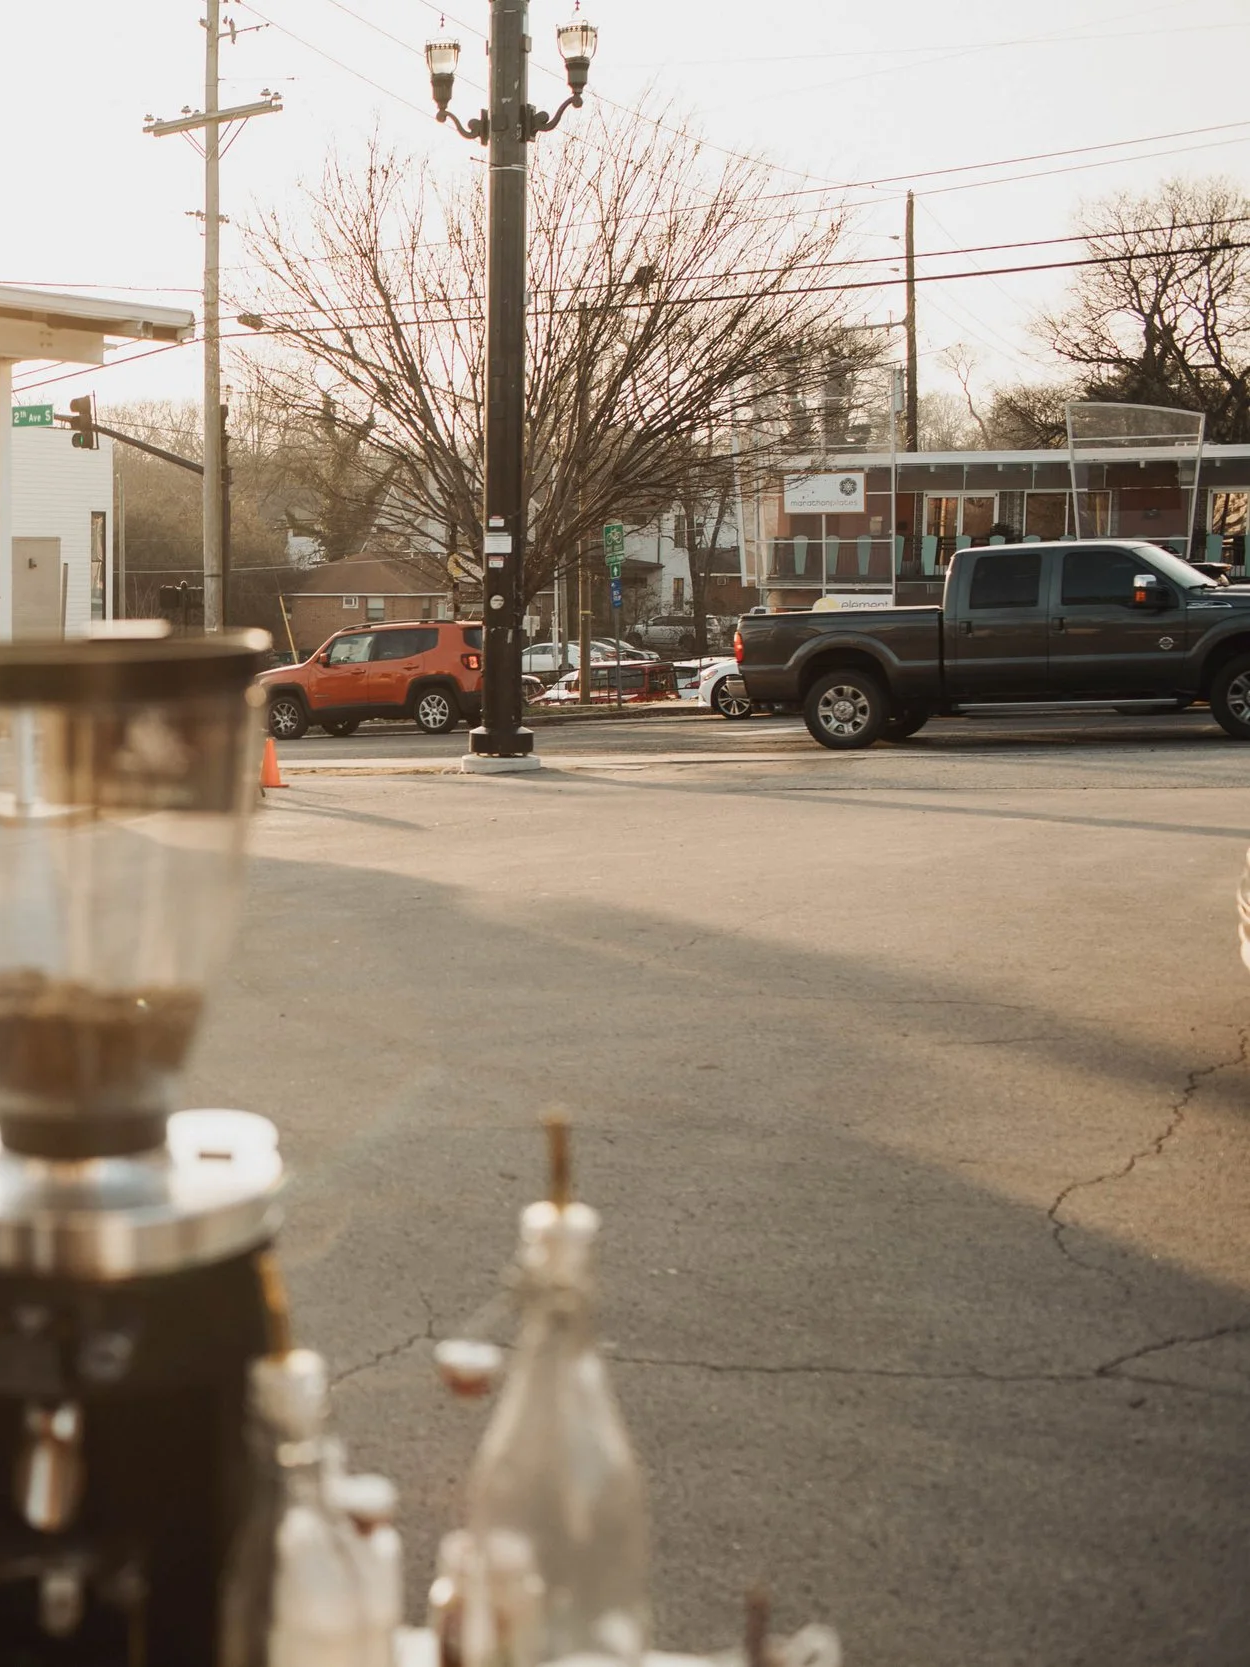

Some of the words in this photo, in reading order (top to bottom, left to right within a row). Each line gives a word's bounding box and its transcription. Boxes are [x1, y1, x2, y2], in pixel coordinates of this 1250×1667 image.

[13, 410, 27, 424] 2th
[29, 413, 42, 423] Ave
[45, 410, 51, 422] S
